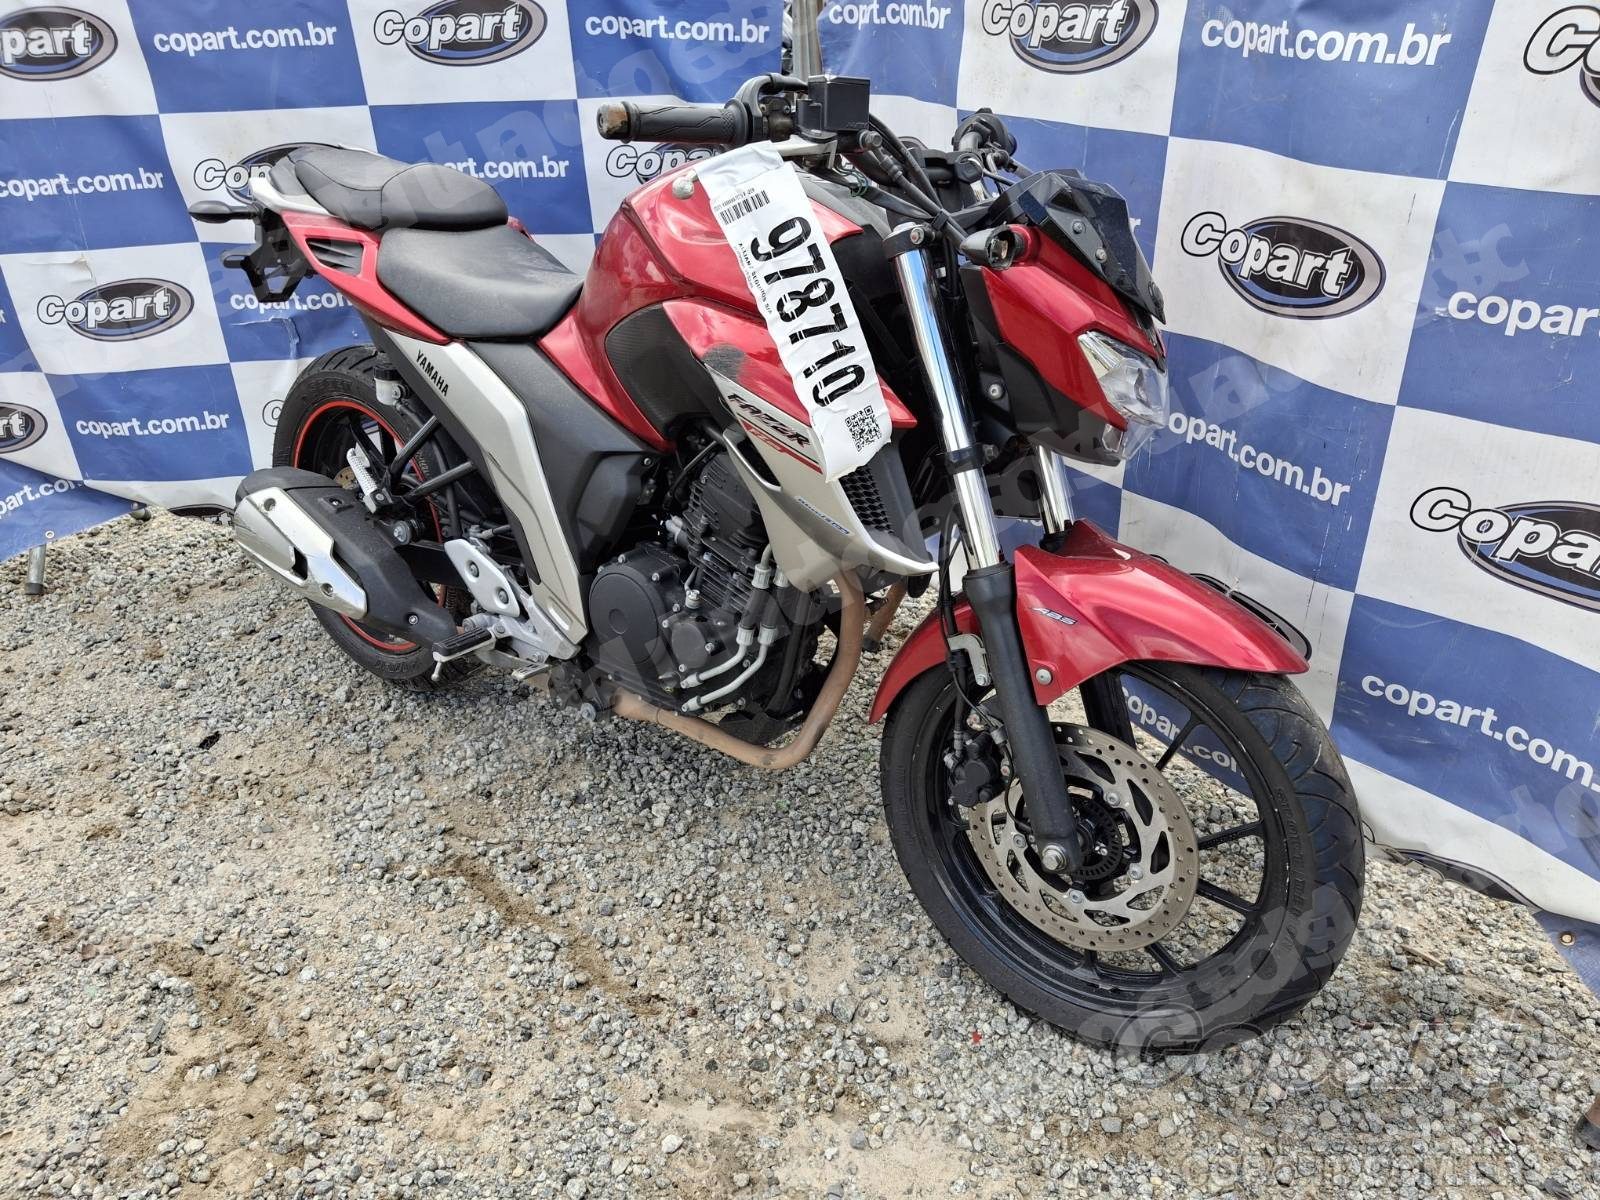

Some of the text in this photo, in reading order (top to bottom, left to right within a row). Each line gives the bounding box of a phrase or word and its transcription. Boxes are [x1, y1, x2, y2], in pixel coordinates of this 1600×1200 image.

[153, 22, 337, 56] copart.com.br
[373, 3, 523, 52] Copart
[585, 15, 770, 44] copart.com.br
[982, 0, 1130, 49] Copart
[1200, 18, 1452, 66] copart.com.br
[1181, 211, 1354, 299] Copart
[37, 287, 171, 330] Copart
[751, 216, 866, 408] 978710
[1447, 291, 1600, 337] copar
[416, 349, 449, 397] YAMAHA
[76, 411, 230, 439] copart.com.br
[1168, 412, 1350, 506] opart.com.br
[1409, 486, 1600, 581] Copa
